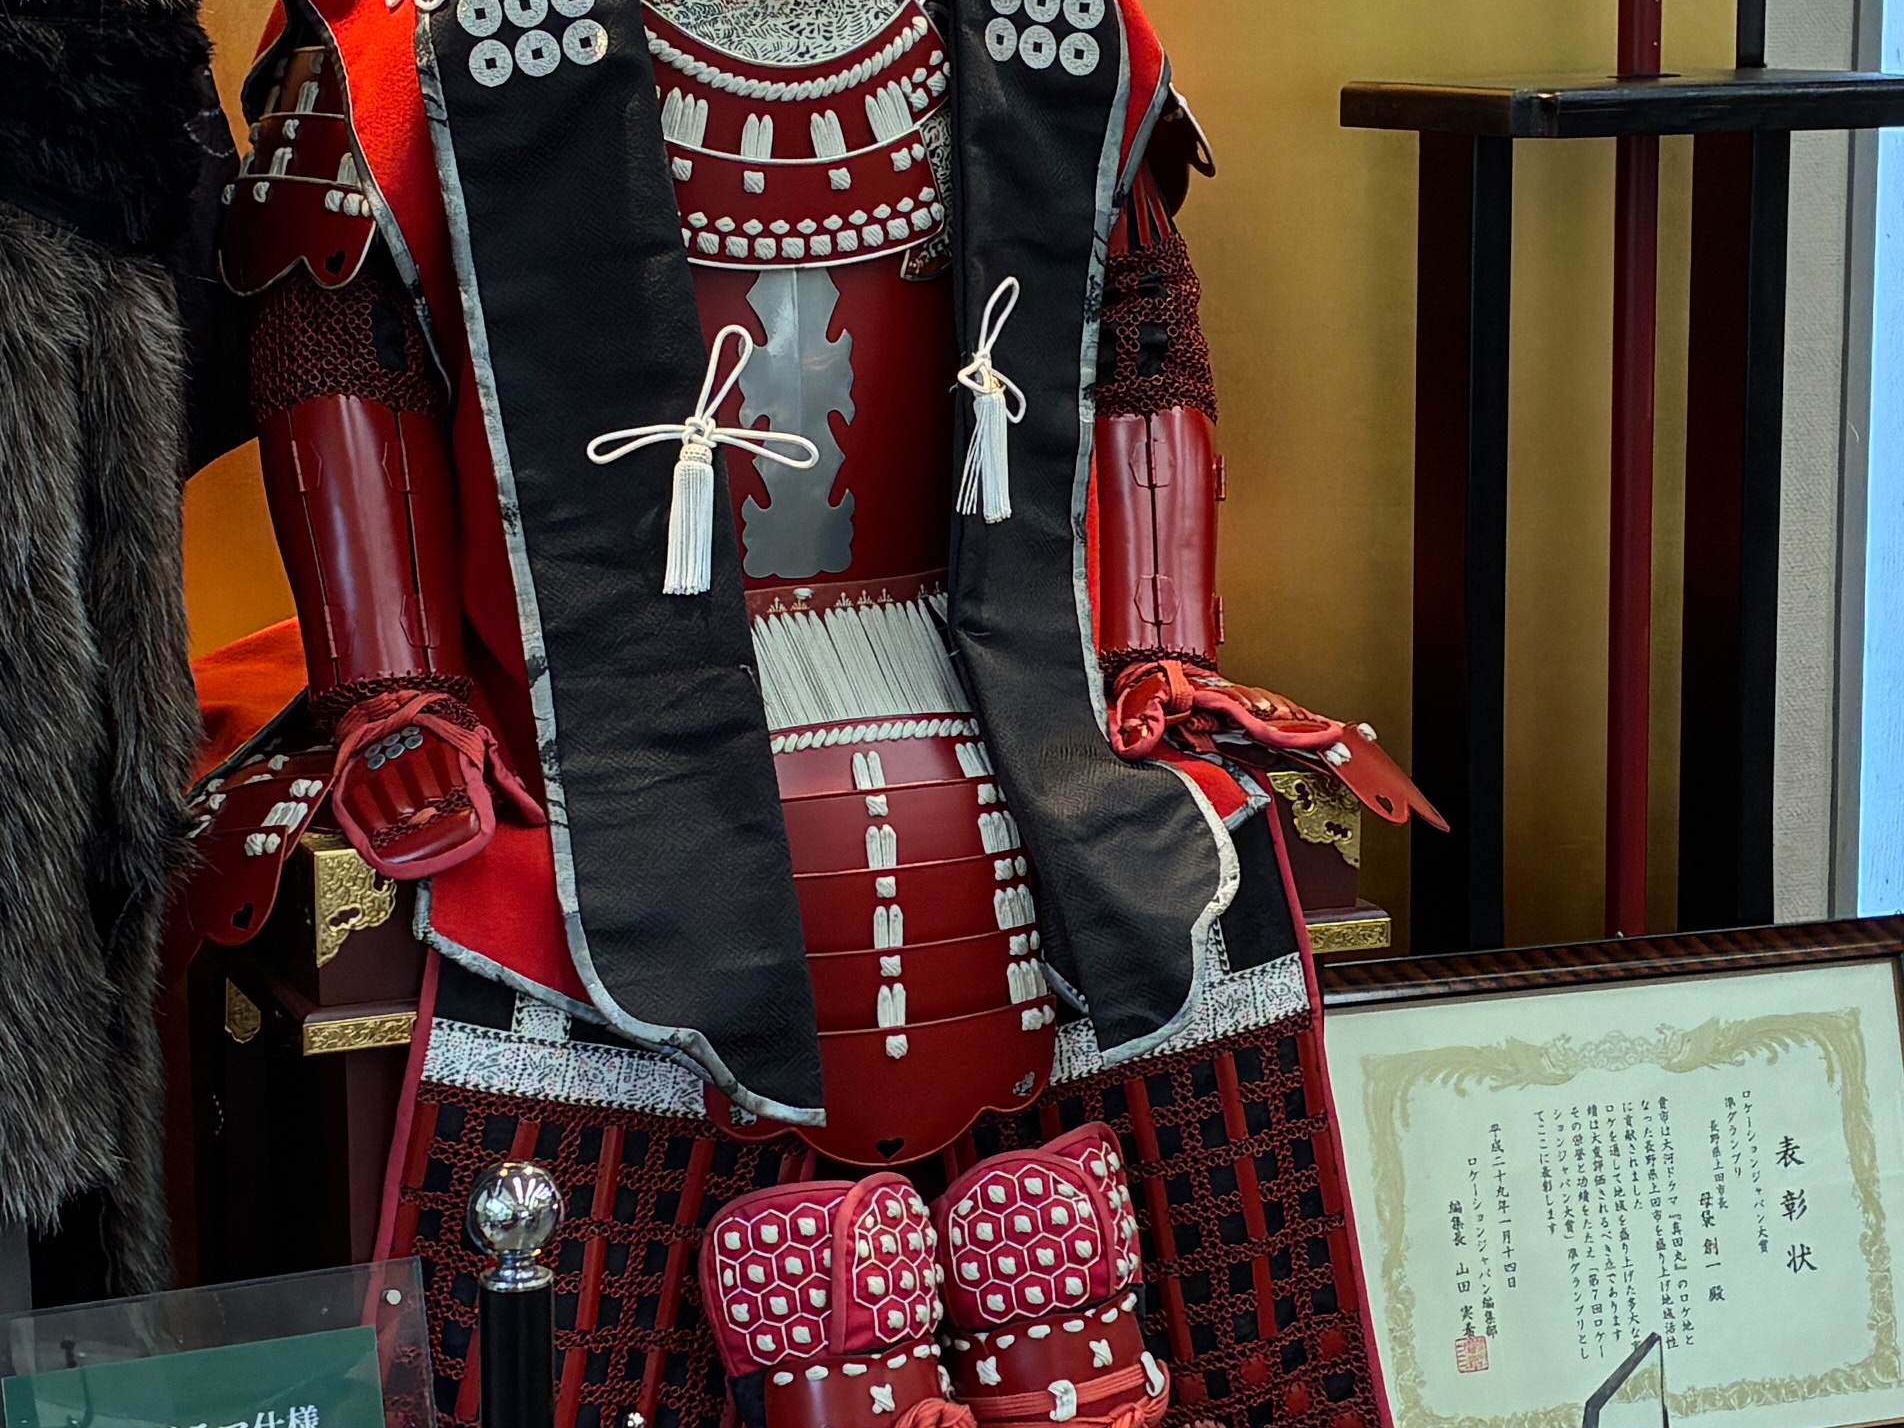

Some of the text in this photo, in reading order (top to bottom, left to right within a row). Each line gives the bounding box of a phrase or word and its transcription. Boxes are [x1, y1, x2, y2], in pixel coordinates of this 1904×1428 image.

[1488, 1123, 1517, 1288] 平成二十九年一月十四日
[1775, 1135, 1818, 1274] 表彰状
